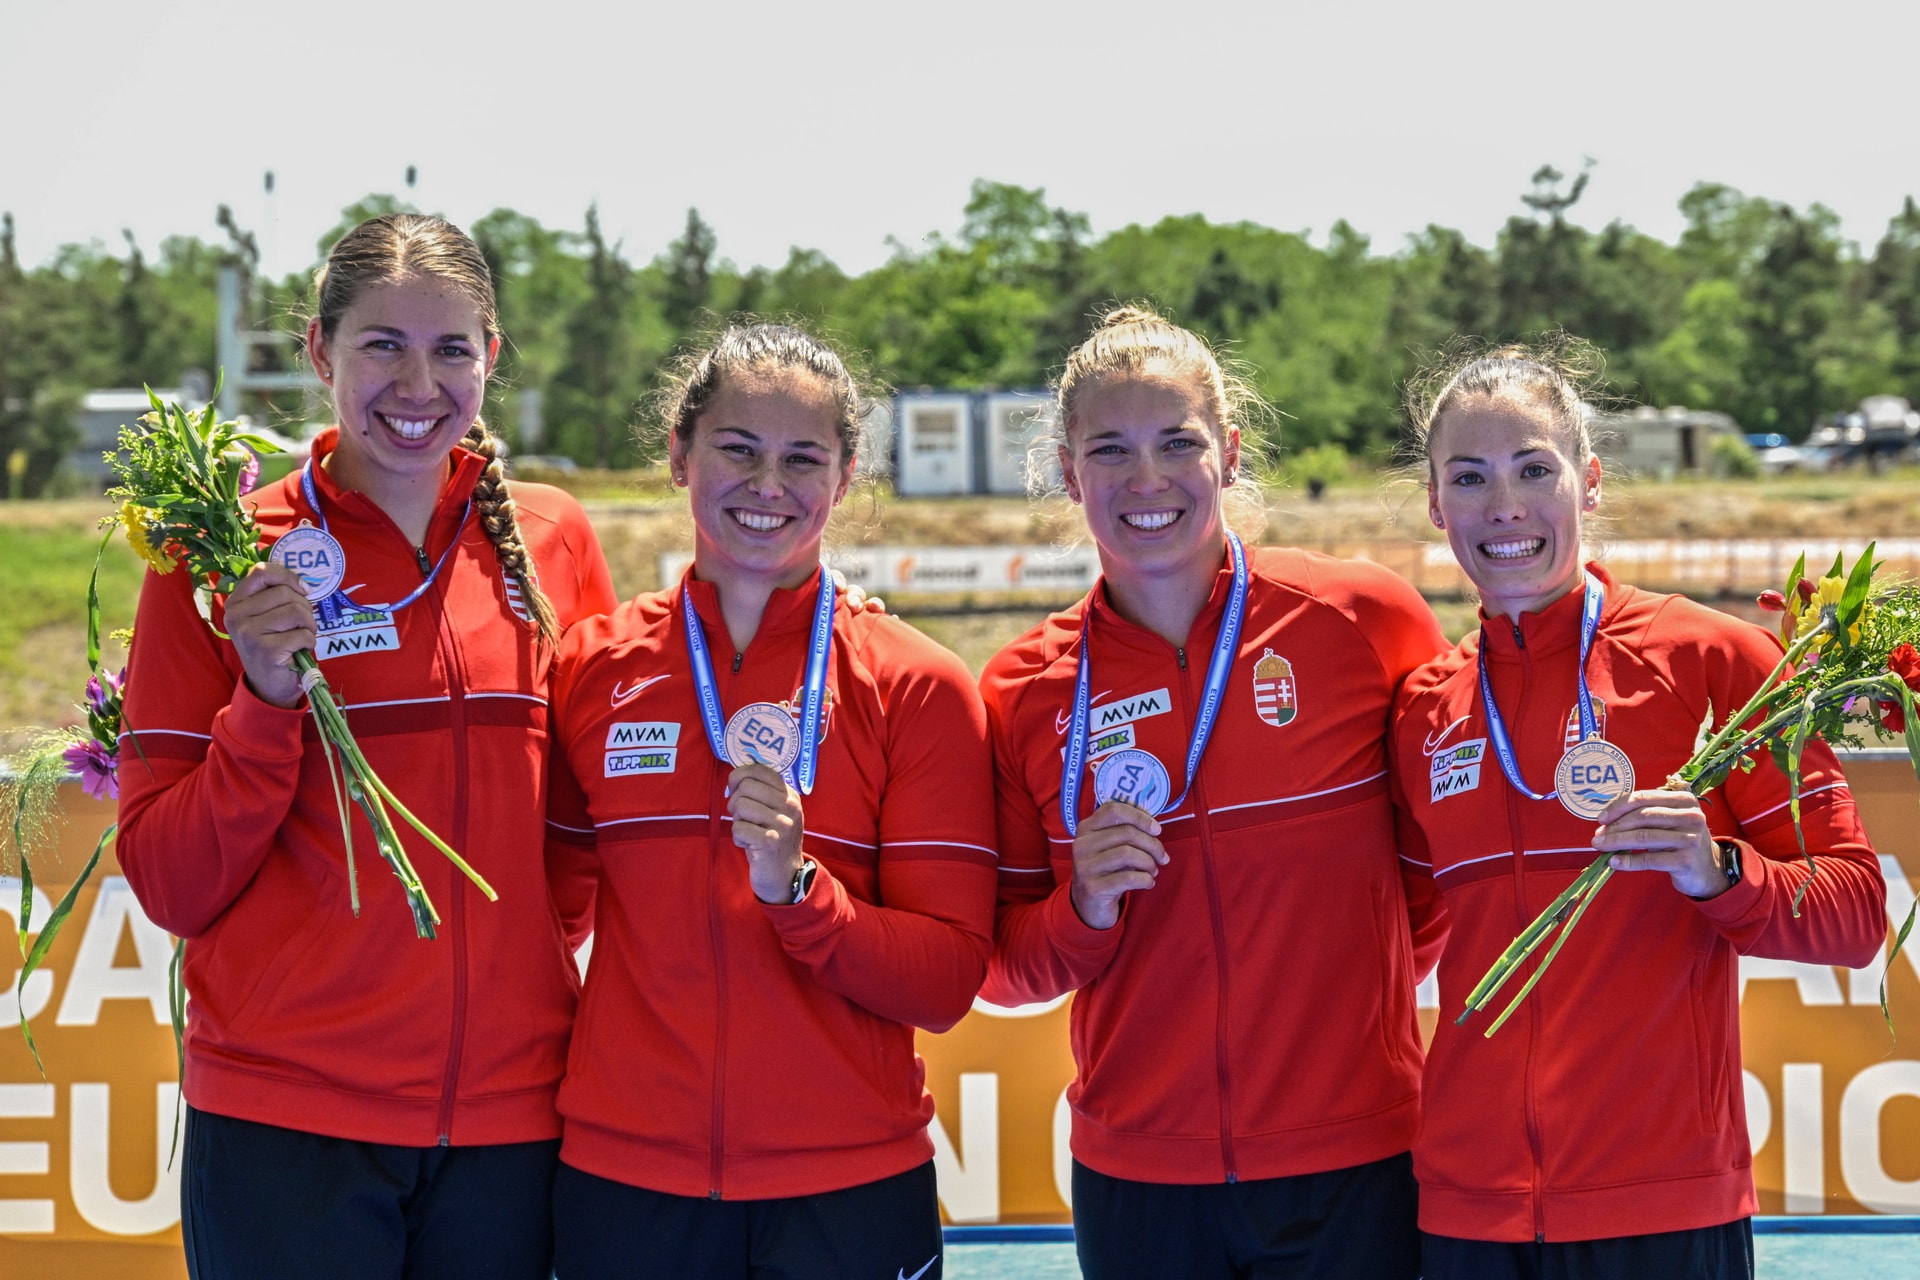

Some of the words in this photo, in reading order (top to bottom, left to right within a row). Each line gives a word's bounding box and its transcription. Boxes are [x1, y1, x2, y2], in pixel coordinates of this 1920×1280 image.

[284, 549, 331, 569] ECA
[816, 605, 830, 655] EUROPEAN
[1222, 582, 1243, 651] ASSOCIATION
[326, 633, 388, 655] MVM
[703, 685, 720, 732] EUROPEAN
[803, 689, 818, 754] ASSOCIATION
[1074, 681, 1087, 735] EUROPEAN
[1101, 697, 1161, 726] MVM
[1198, 687, 1218, 740] EUROPEAN
[613, 727, 667, 743] MVM
[742, 717, 786, 756] ECA
[1068, 738, 1081, 775] CANOE
[1559, 751, 1576, 794] EUROPEAN
[1610, 750, 1631, 793] ASSOCIATION
[1571, 764, 1620, 785] ECA
[1109, 764, 1145, 804] ECA
